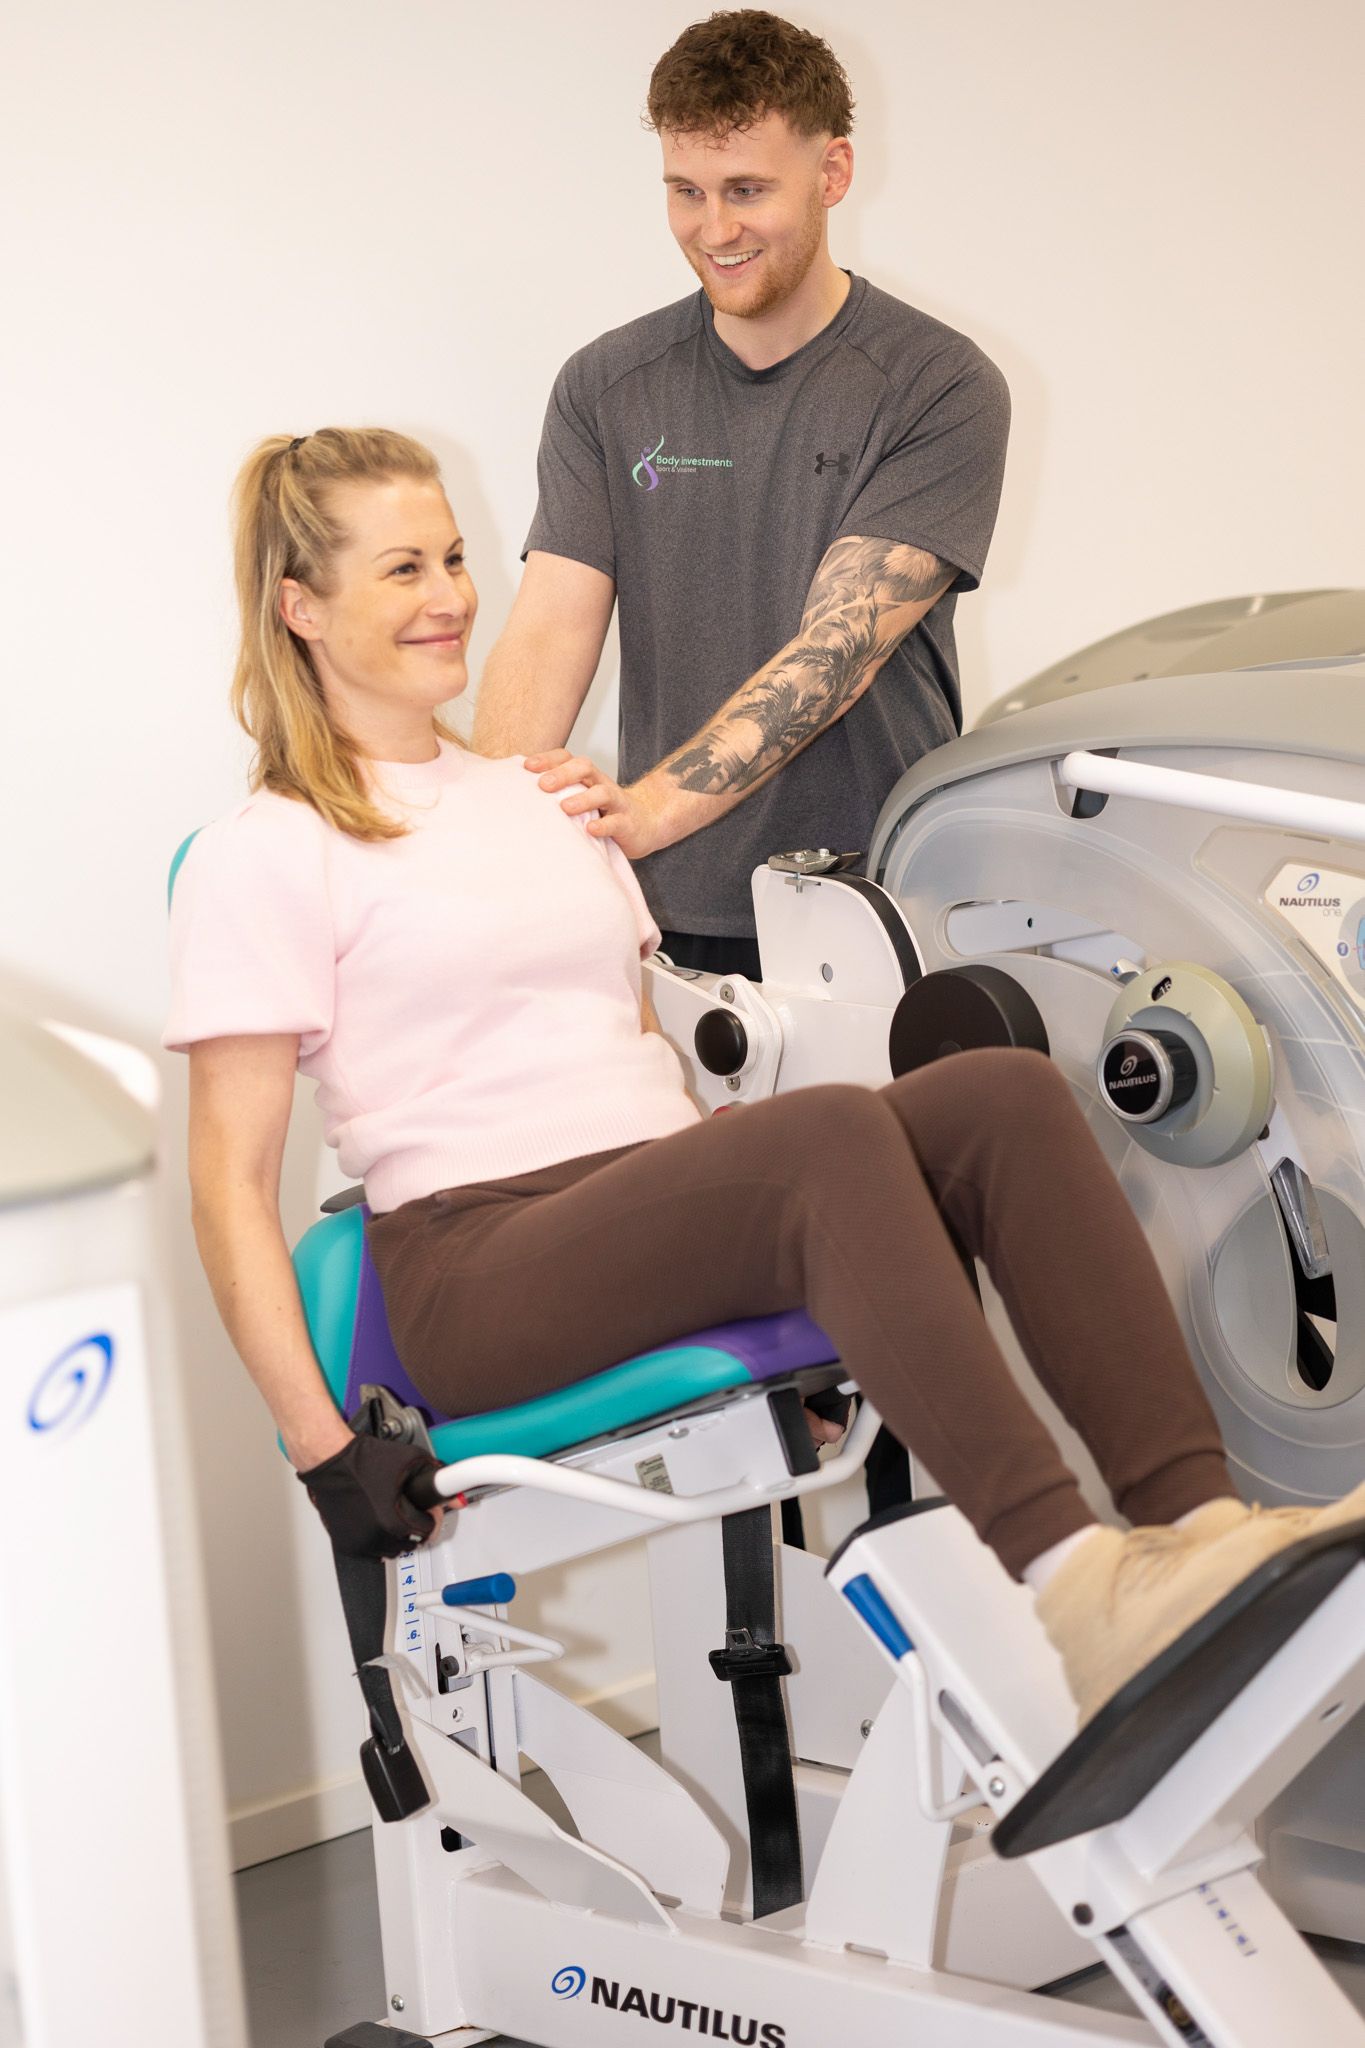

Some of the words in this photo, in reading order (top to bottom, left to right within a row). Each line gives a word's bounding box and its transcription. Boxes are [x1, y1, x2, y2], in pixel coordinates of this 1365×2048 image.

[656, 455, 680, 467] Body
[681, 456, 733, 467] investments
[656, 465, 671, 473] Sport
[1279, 897, 1341, 907] NAUTILUS
[1108, 1074, 1158, 1090] NAUTILUS
[591, 1976, 786, 2048] NAUTILUS
